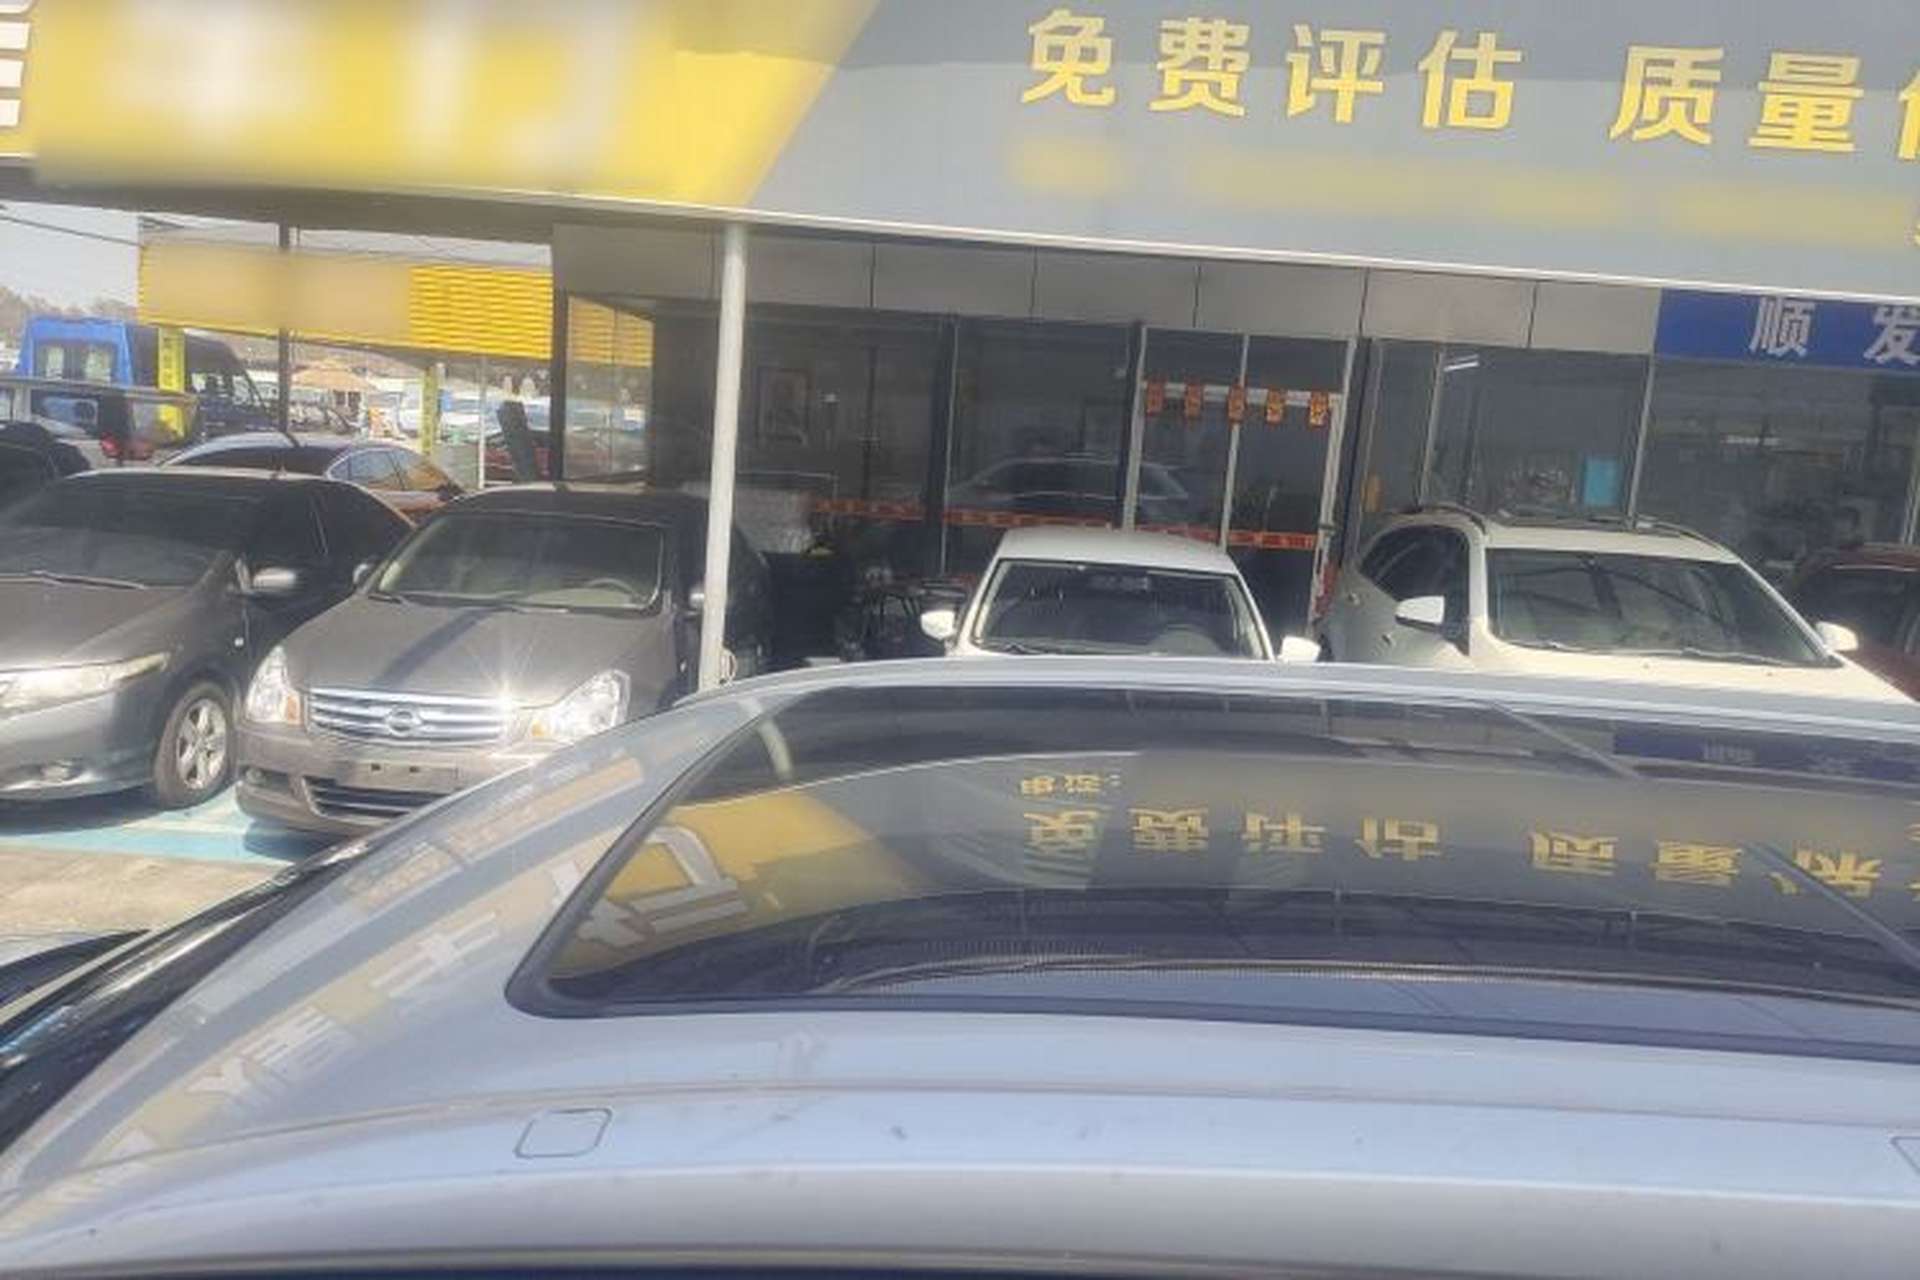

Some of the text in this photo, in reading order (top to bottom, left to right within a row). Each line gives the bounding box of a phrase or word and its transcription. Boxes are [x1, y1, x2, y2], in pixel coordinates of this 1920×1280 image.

[1021, 8, 1920, 160] 免费评估 质量
[1749, 294, 1920, 365] 顺发
